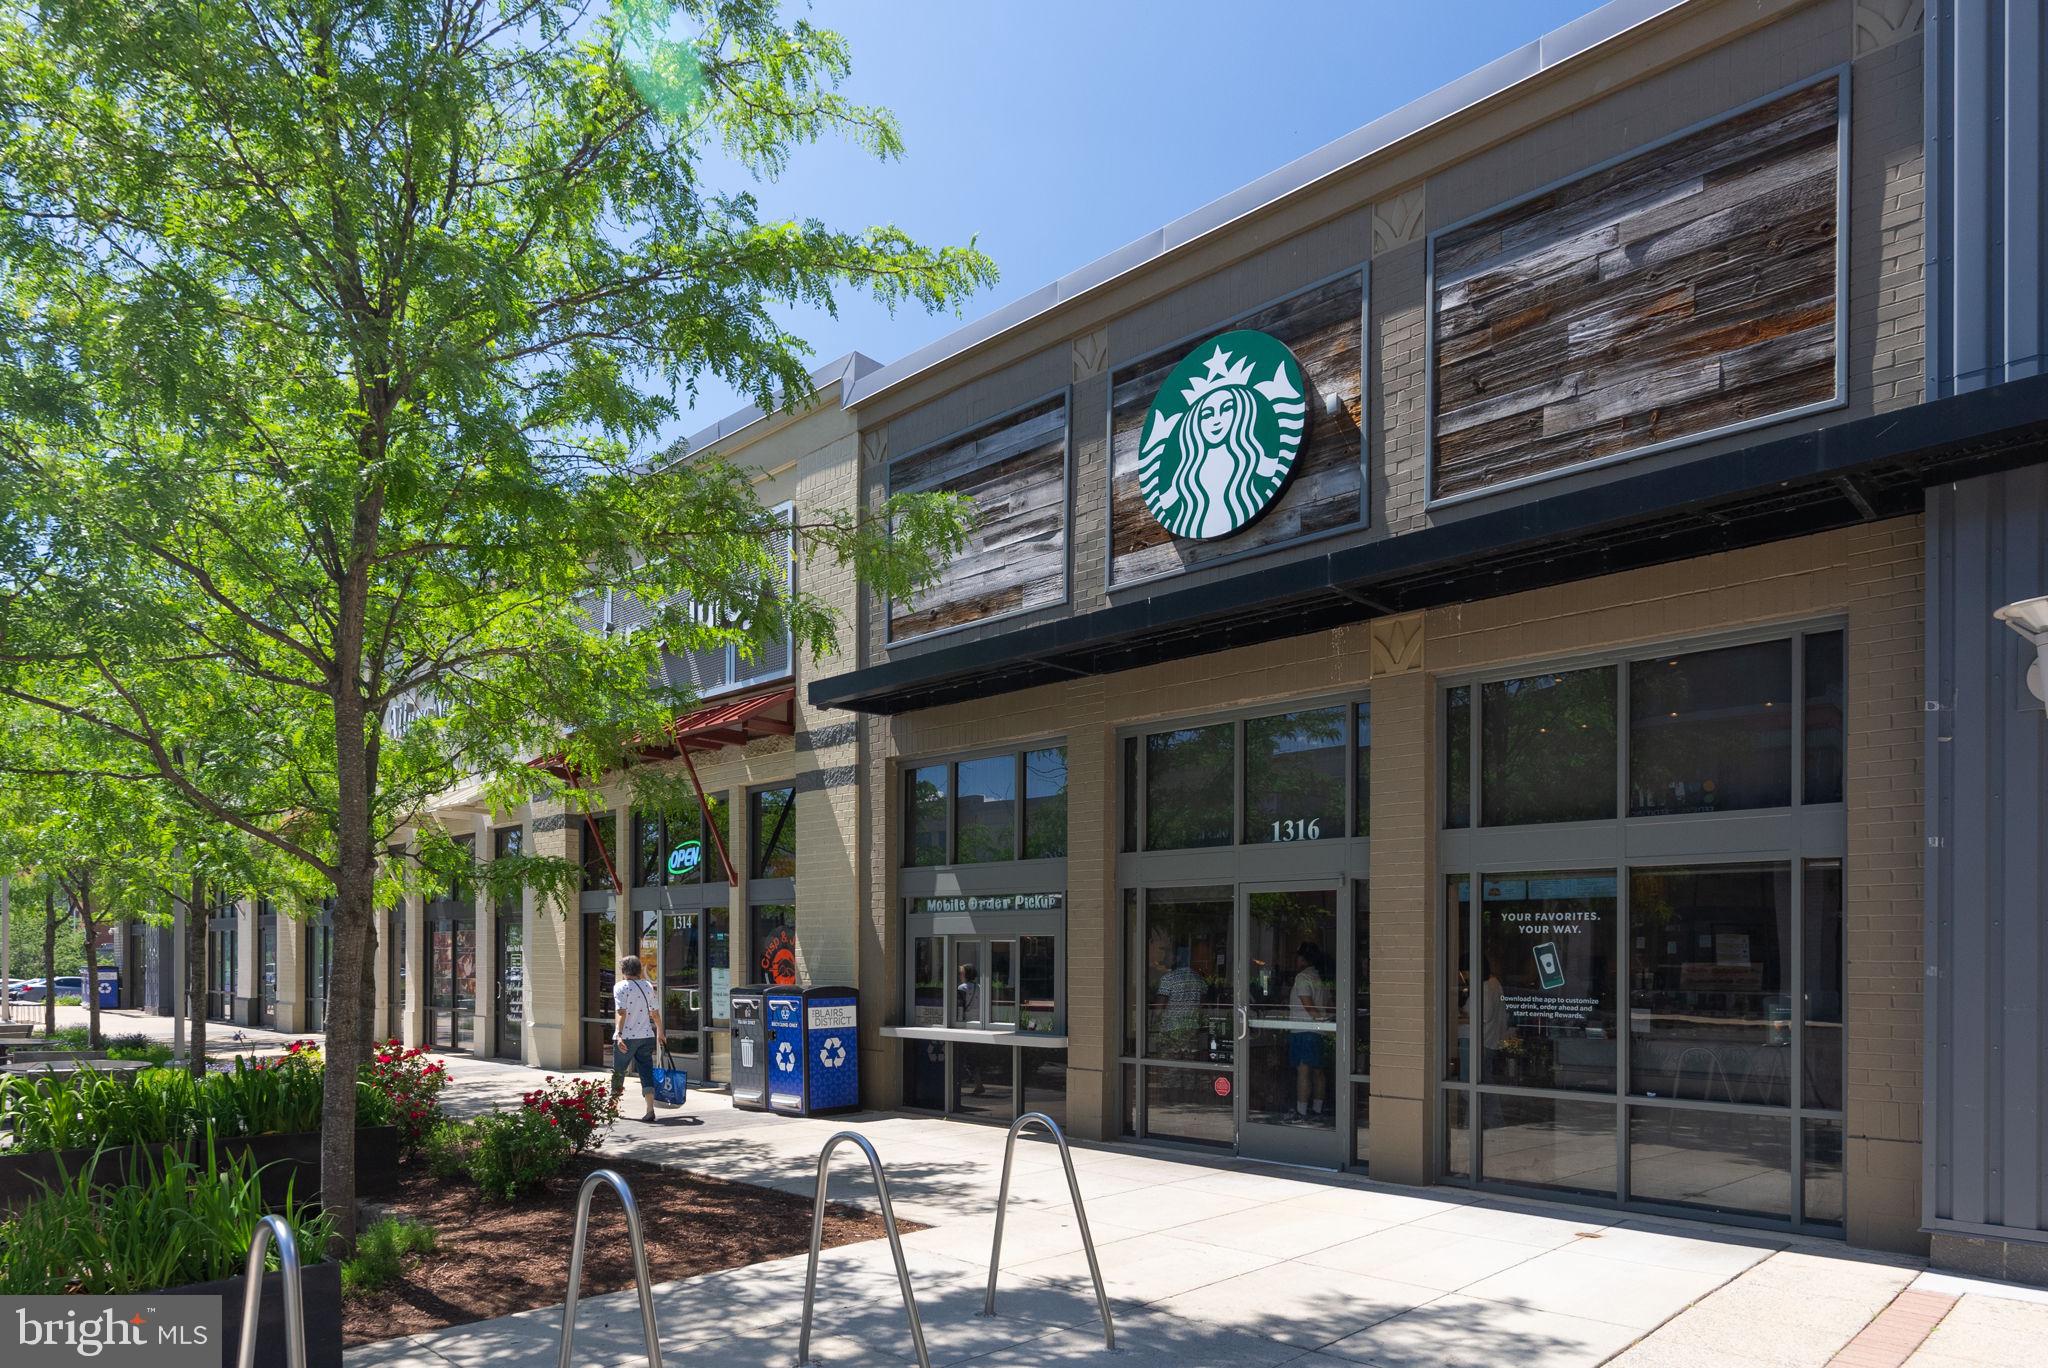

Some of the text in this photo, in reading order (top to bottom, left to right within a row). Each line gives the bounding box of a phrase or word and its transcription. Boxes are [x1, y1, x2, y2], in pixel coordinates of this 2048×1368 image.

[1271, 817, 1320, 842] 1316
[670, 846, 700, 869] OPEN
[927, 897, 966, 912] Mobile
[968, 896, 1011, 911] Order
[1501, 911, 1601, 921] YOUR FAVORITES.
[673, 915, 692, 930] 1314
[1519, 925, 1582, 934] YOUR WAY.
[761, 936, 780, 969] Crisp
[1500, 994, 1532, 1003] Download
[1532, 995, 1544, 1003] the
[1565, 997, 1599, 1005] customize
[814, 1008, 844, 1018] BLAIRS
[1529, 1011, 1554, 1019] earning
[1554, 1011, 1585, 1019] Rewards.
[814, 1015, 852, 1027] DISTRICT
